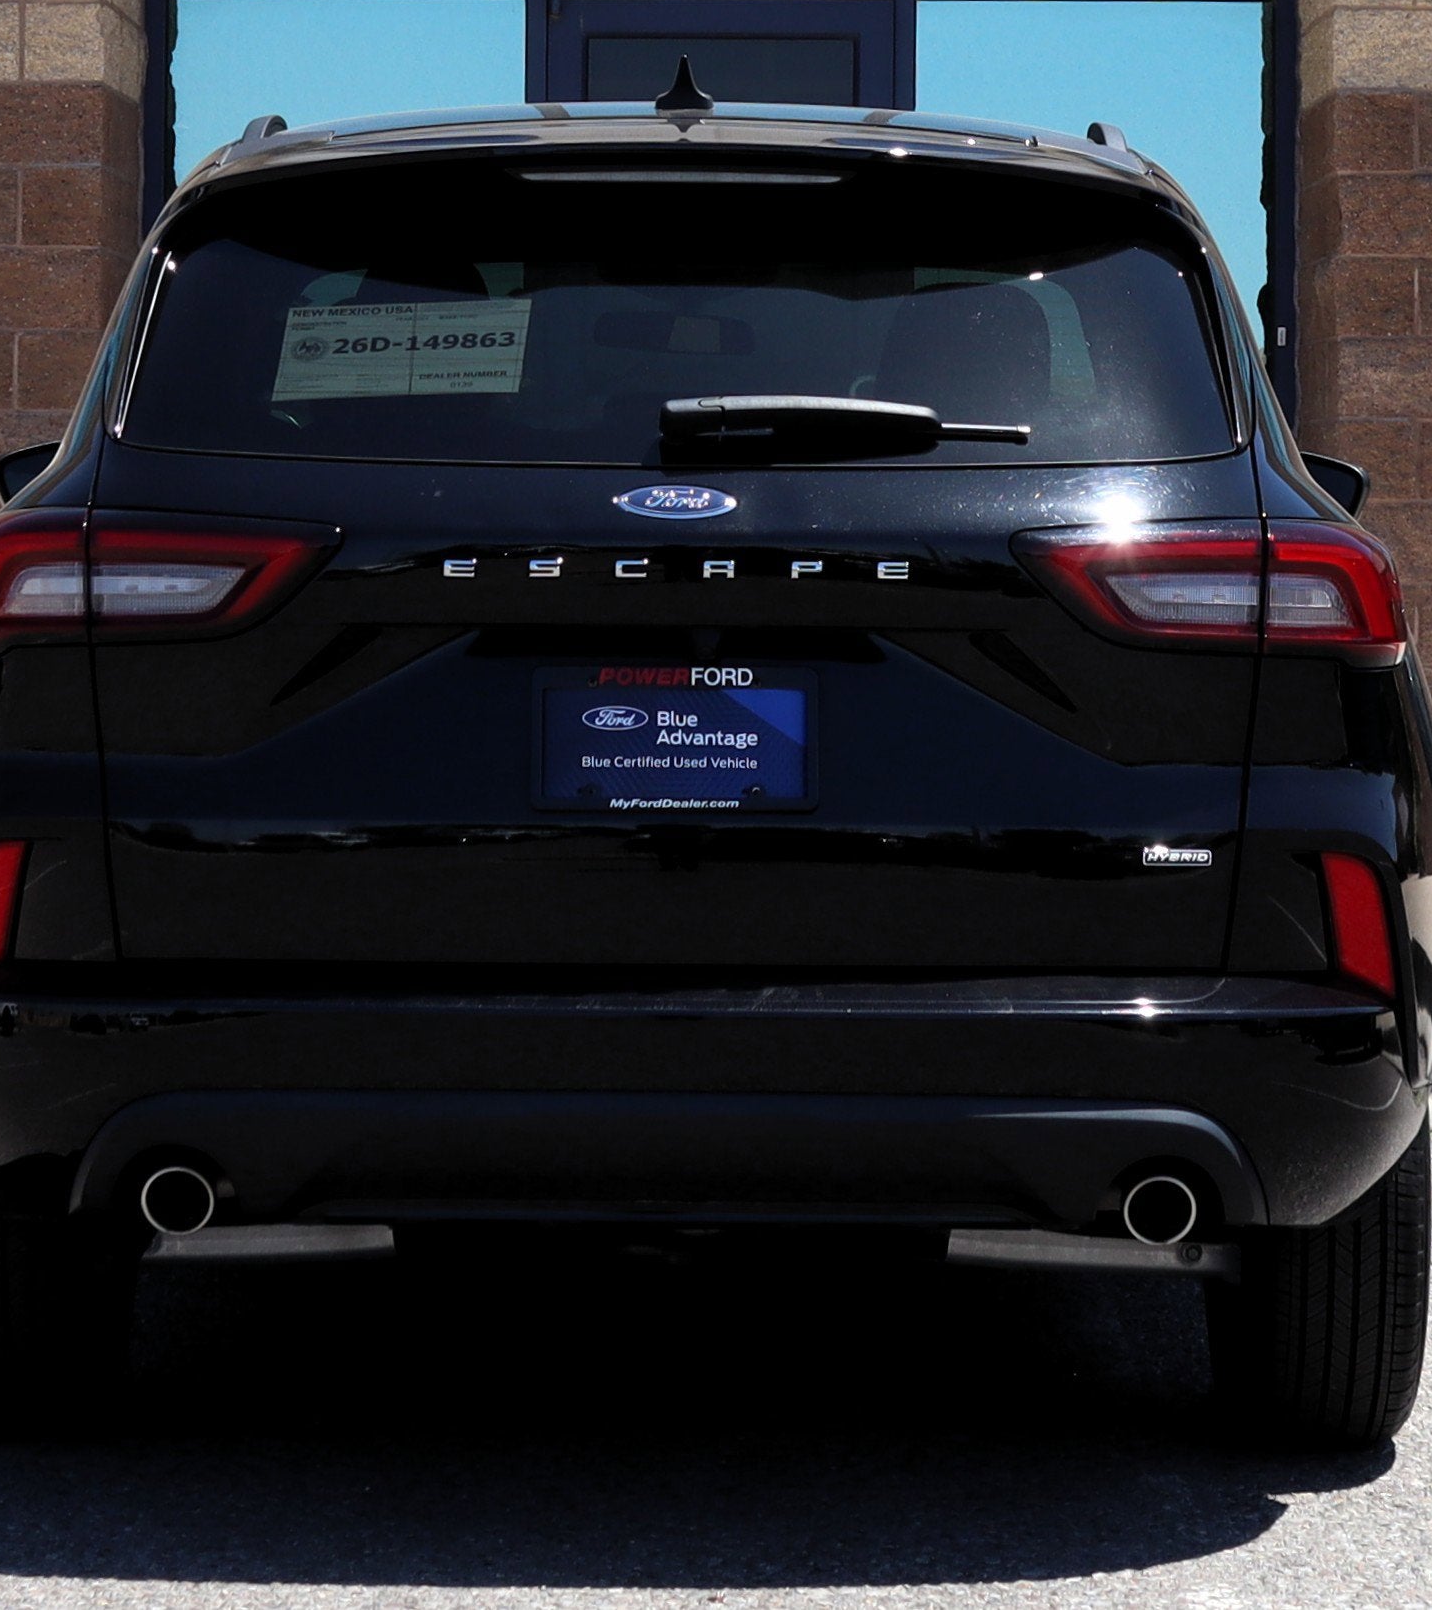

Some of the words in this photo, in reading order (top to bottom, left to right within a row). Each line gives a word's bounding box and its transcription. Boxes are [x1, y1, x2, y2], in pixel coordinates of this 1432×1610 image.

[291, 307, 325, 318] NEW
[327, 306, 381, 317] MEXICO
[385, 305, 414, 315] USA
[332, 331, 516, 355] 26D-149863
[418, 372, 461, 380] DEALER
[462, 370, 507, 379] NUMBER
[644, 489, 710, 509] Ford
[442, 558, 910, 580] ESCAPE
[598, 666, 754, 686] POWERFORD
[594, 709, 636, 728] Ford
[656, 711, 698, 727] Blue
[656, 730, 759, 749] Advantage
[581, 756, 611, 768] Blue
[614, 756, 671, 768] Certified
[673, 756, 708, 768] Used
[711, 757, 758, 769] Vehicle
[609, 798, 740, 810] MyFordDealer.com
[1146, 851, 1209, 862] HYBRID
